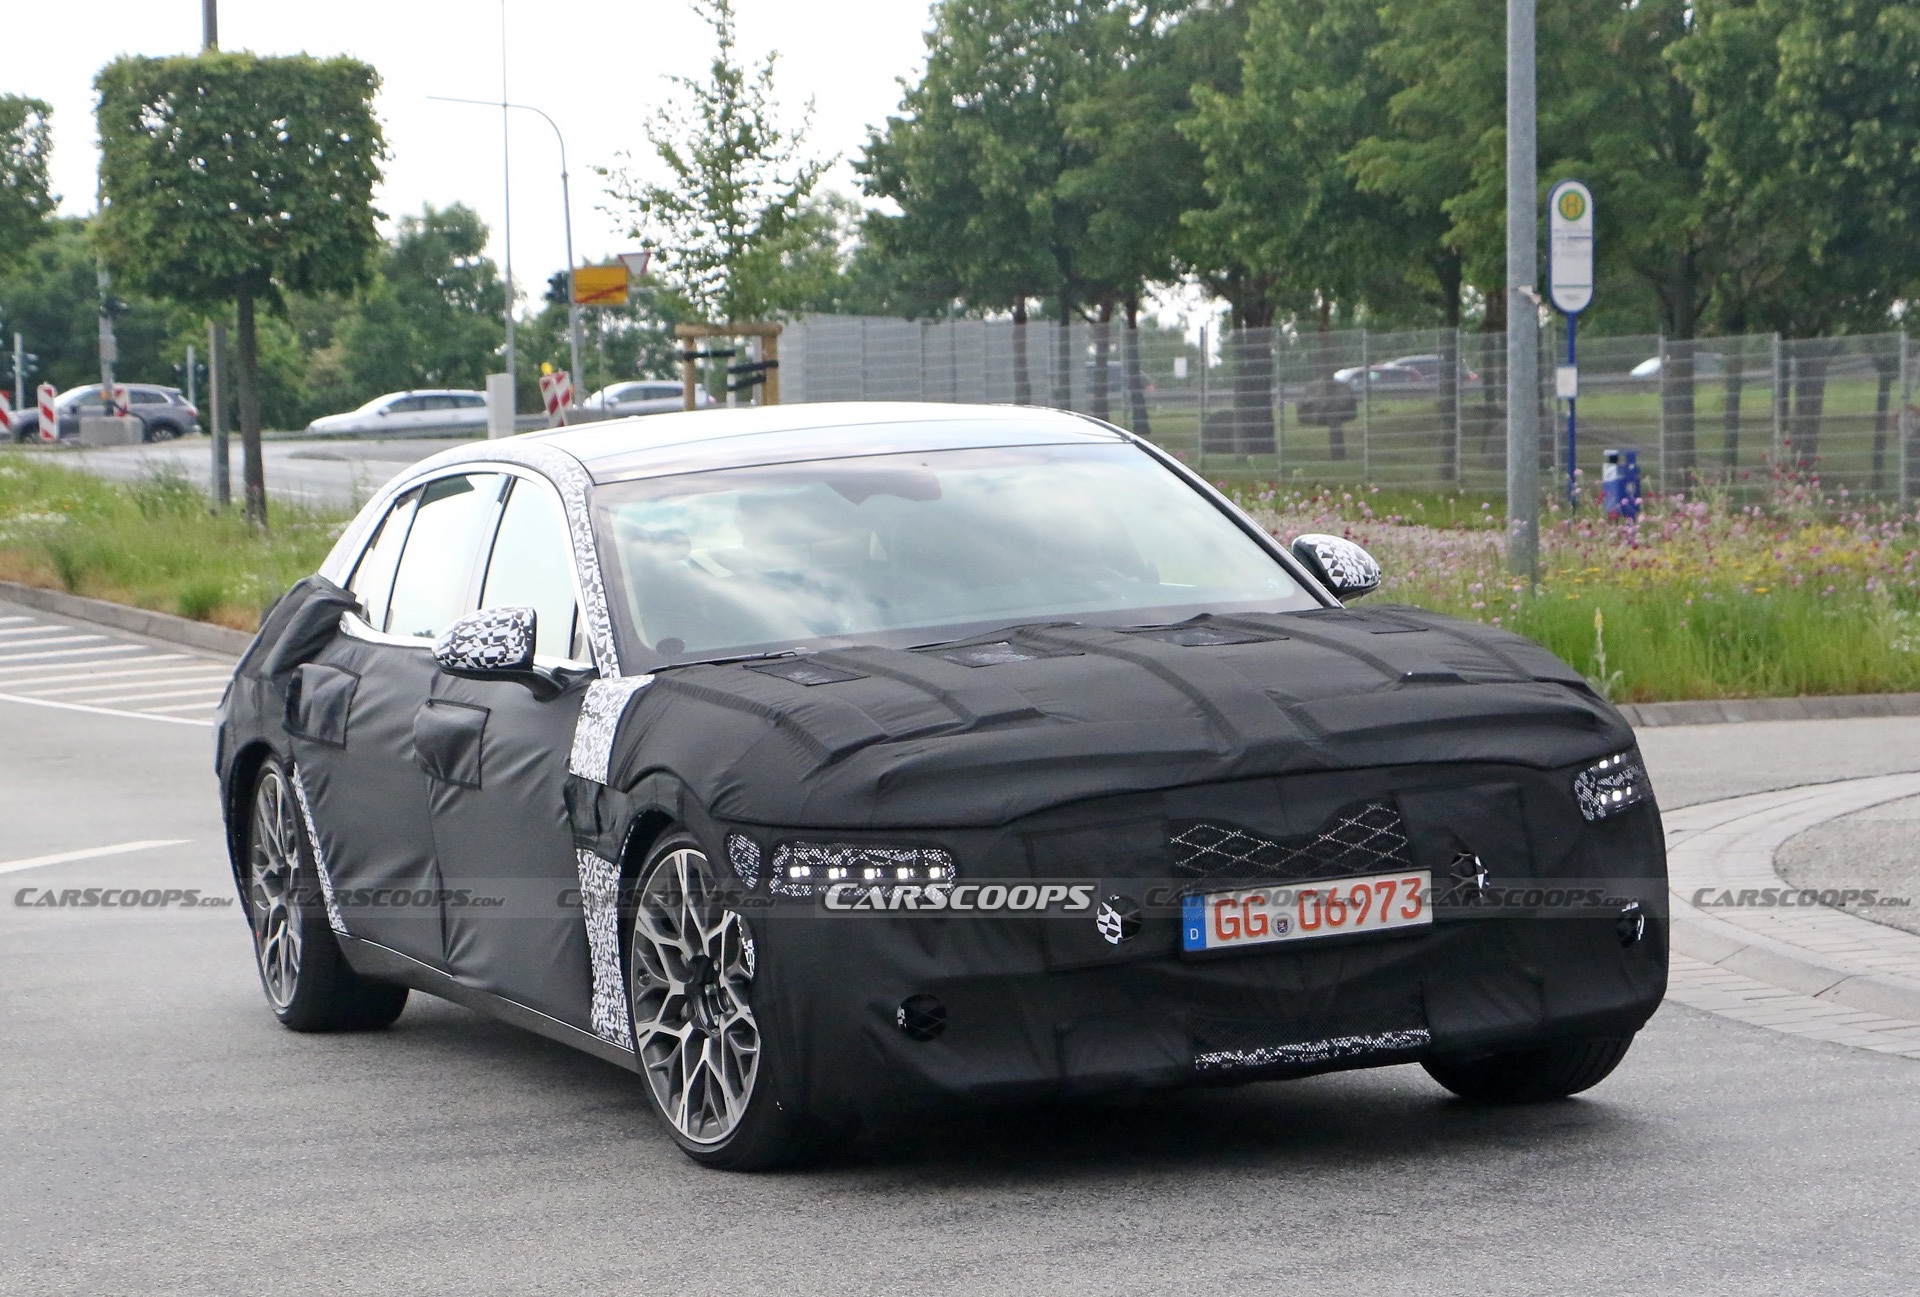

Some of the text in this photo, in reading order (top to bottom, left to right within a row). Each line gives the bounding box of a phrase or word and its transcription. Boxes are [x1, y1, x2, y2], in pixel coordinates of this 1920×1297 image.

[1214, 877, 1423, 940] GG 06973
[1190, 928, 1199, 941] D
